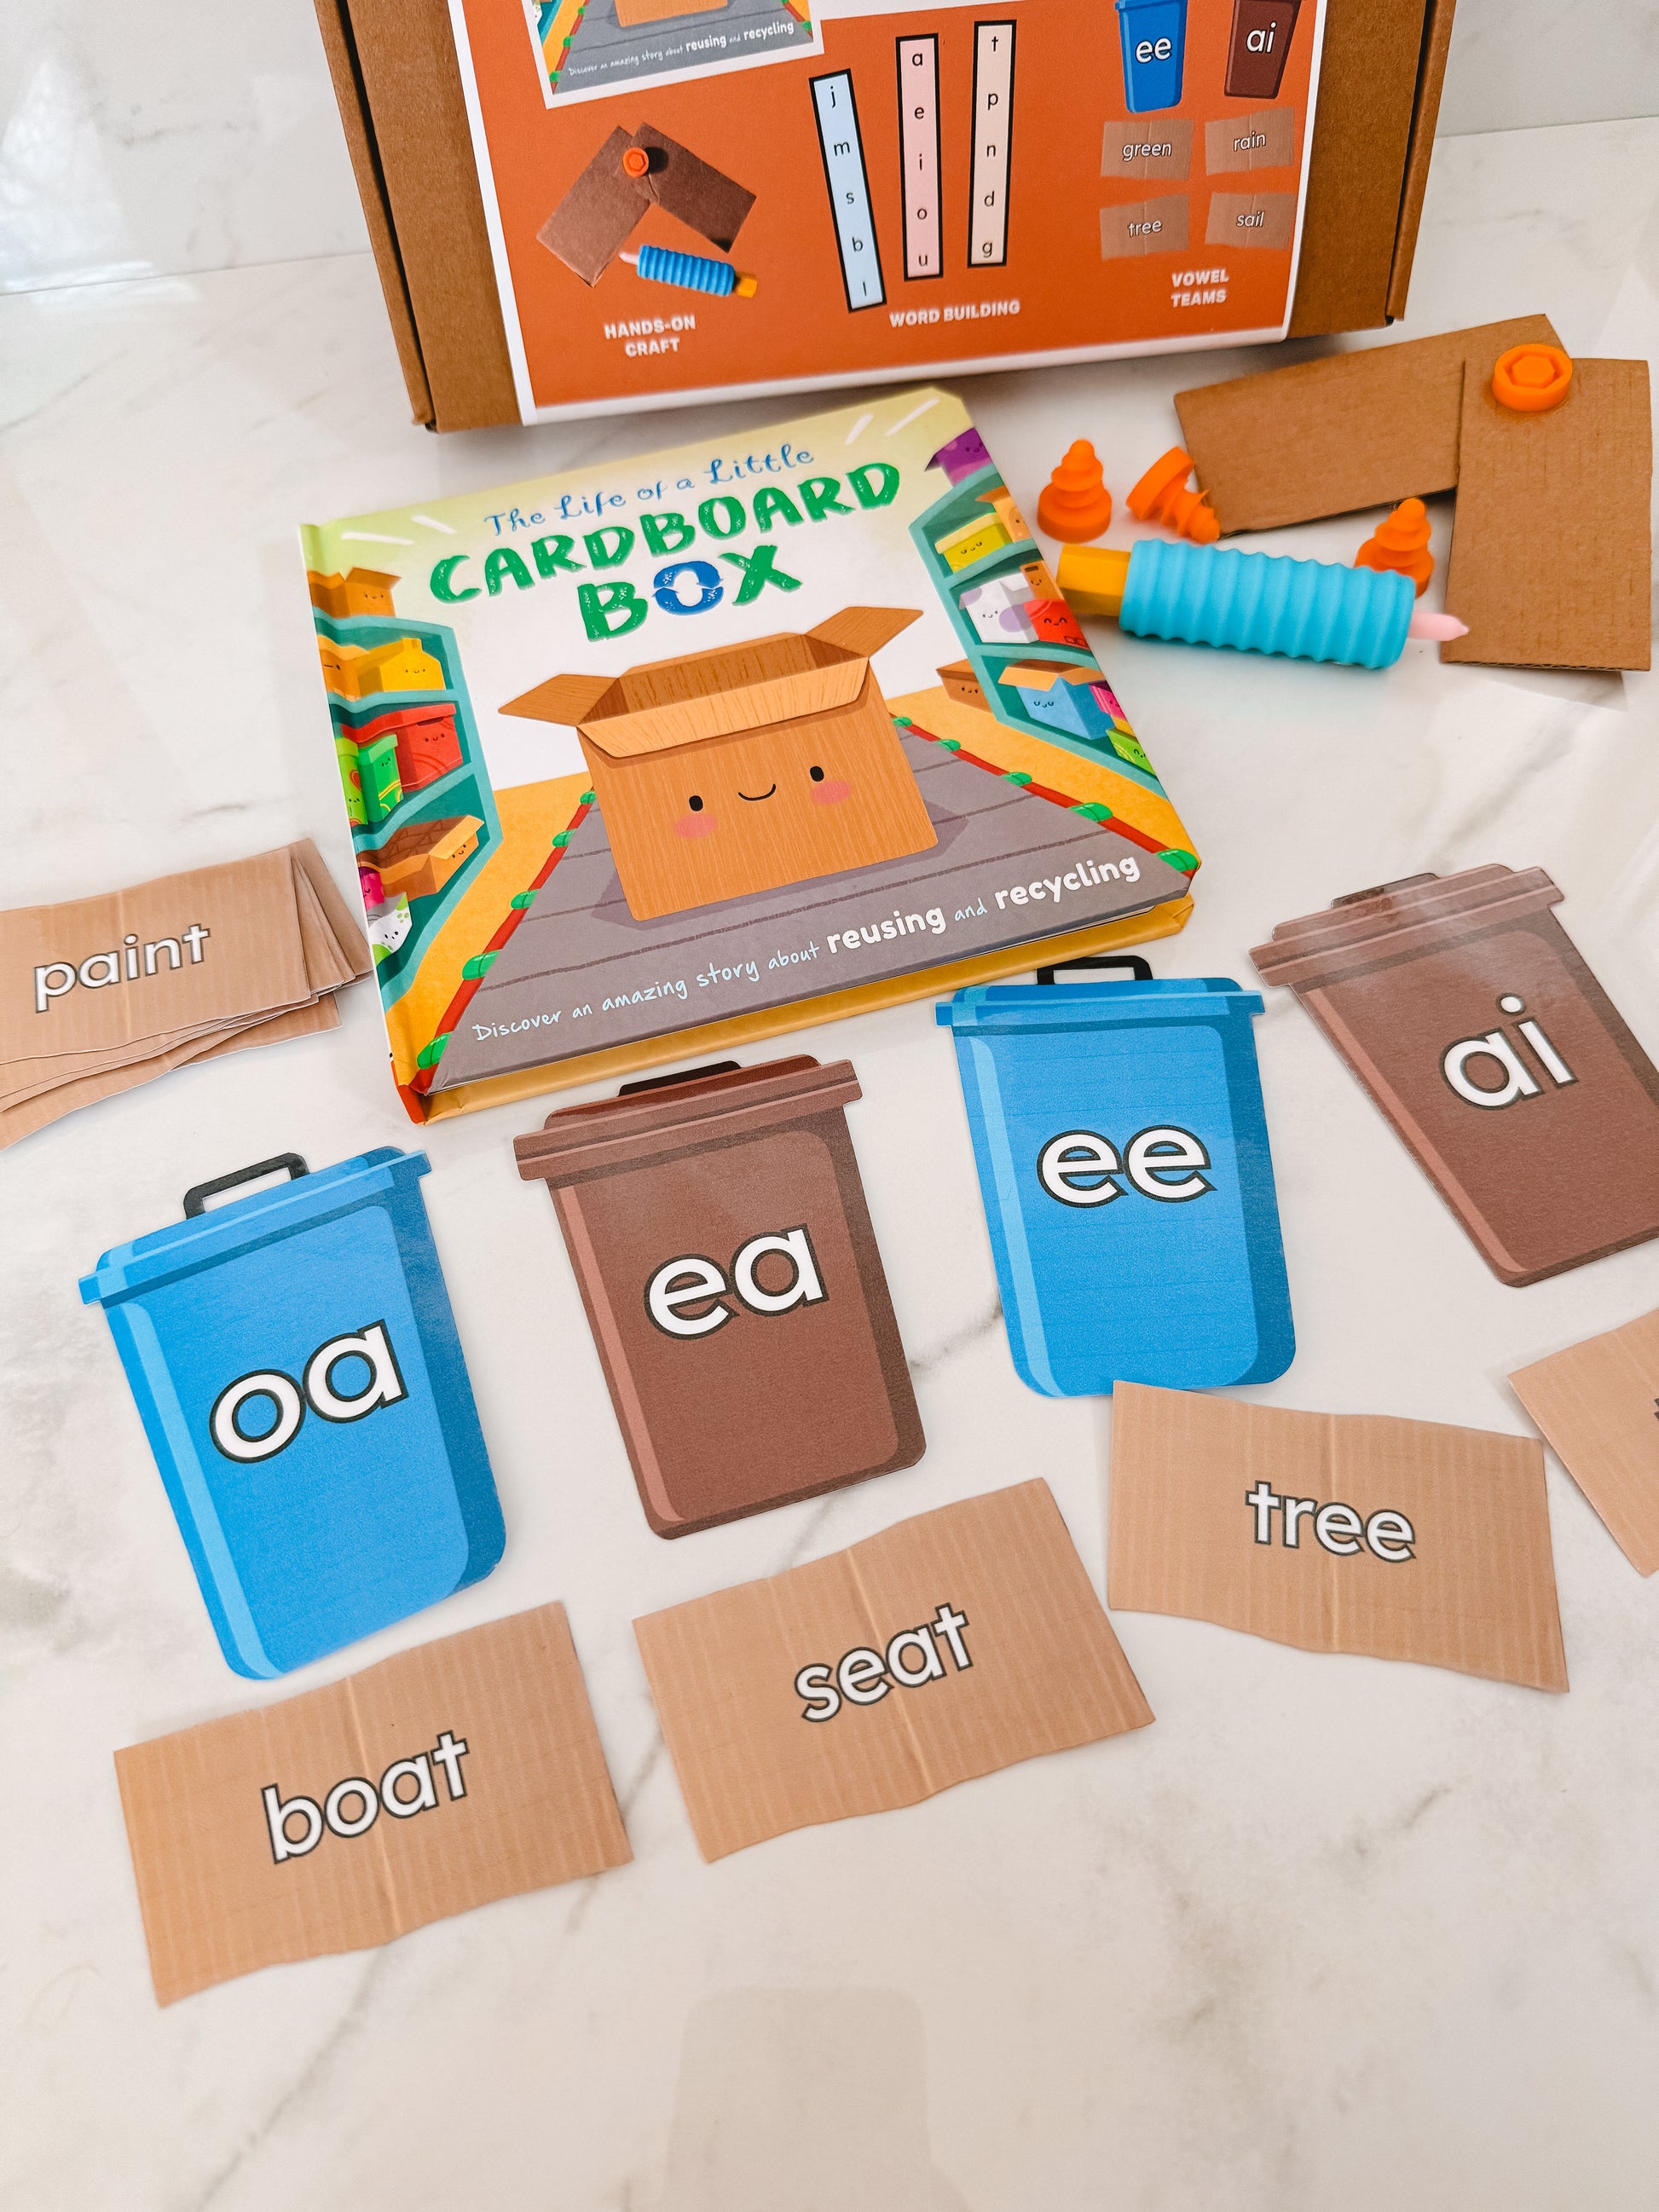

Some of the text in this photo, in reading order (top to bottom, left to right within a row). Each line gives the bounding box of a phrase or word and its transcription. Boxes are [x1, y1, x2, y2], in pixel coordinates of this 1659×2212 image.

[569, 65, 598, 76] Discover
[610, 55, 639, 67] amazing
[642, 50, 663, 61] story
[665, 46, 684, 57] about
[685, 35, 726, 52] reusing
[729, 33, 741, 43] and
[743, 21, 795, 41] recycling
[1136, 37, 1172, 64] ee
[1246, 21, 1277, 53] ai
[911, 53, 928, 267] a e i o u
[982, 36, 999, 258] t p n d g
[1122, 142, 1172, 161] green
[1233, 130, 1267, 152] rain
[830, 86, 867, 296] j m s b l
[1128, 219, 1163, 238] tree
[1236, 211, 1265, 228] sail
[889, 299, 1021, 328] WORD BUILDING
[1171, 269, 1229, 287] VOWEL
[1171, 288, 1227, 308] TEAMS
[603, 313, 697, 340] HANDS-ON
[625, 336, 680, 358] CRAFT
[429, 461, 901, 604] CARDBOARD
[483, 443, 814, 537] The Life of a Little
[575, 543, 803, 643] BOX
[33, 922, 211, 1014] paint
[471, 855, 1142, 1042] Discover an amazing story about reusing and recycling
[1438, 992, 1579, 1111] ai
[1036, 1124, 1218, 1209] ee
[644, 1223, 830, 1341] ea
[209, 1318, 409, 1464] oa
[1245, 1480, 1416, 1563] tree
[794, 1602, 974, 1723] seat
[261, 1730, 471, 1865] boat
